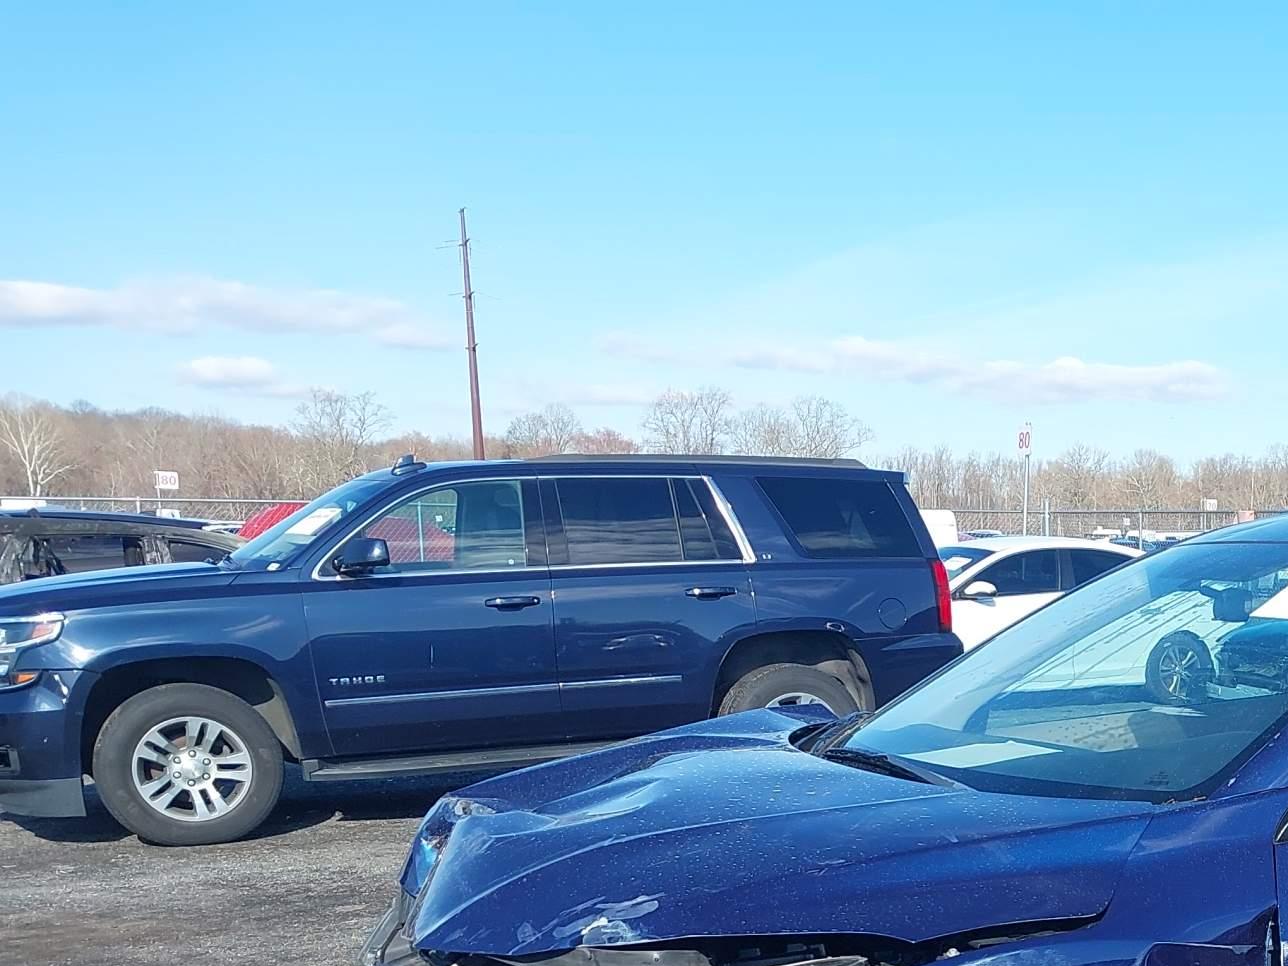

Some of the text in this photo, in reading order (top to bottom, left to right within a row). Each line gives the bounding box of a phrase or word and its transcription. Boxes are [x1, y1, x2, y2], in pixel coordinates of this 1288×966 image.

[1018, 431, 1031, 449] 80
[161, 475, 177, 486] 80
[328, 675, 385, 686] TAHOE
